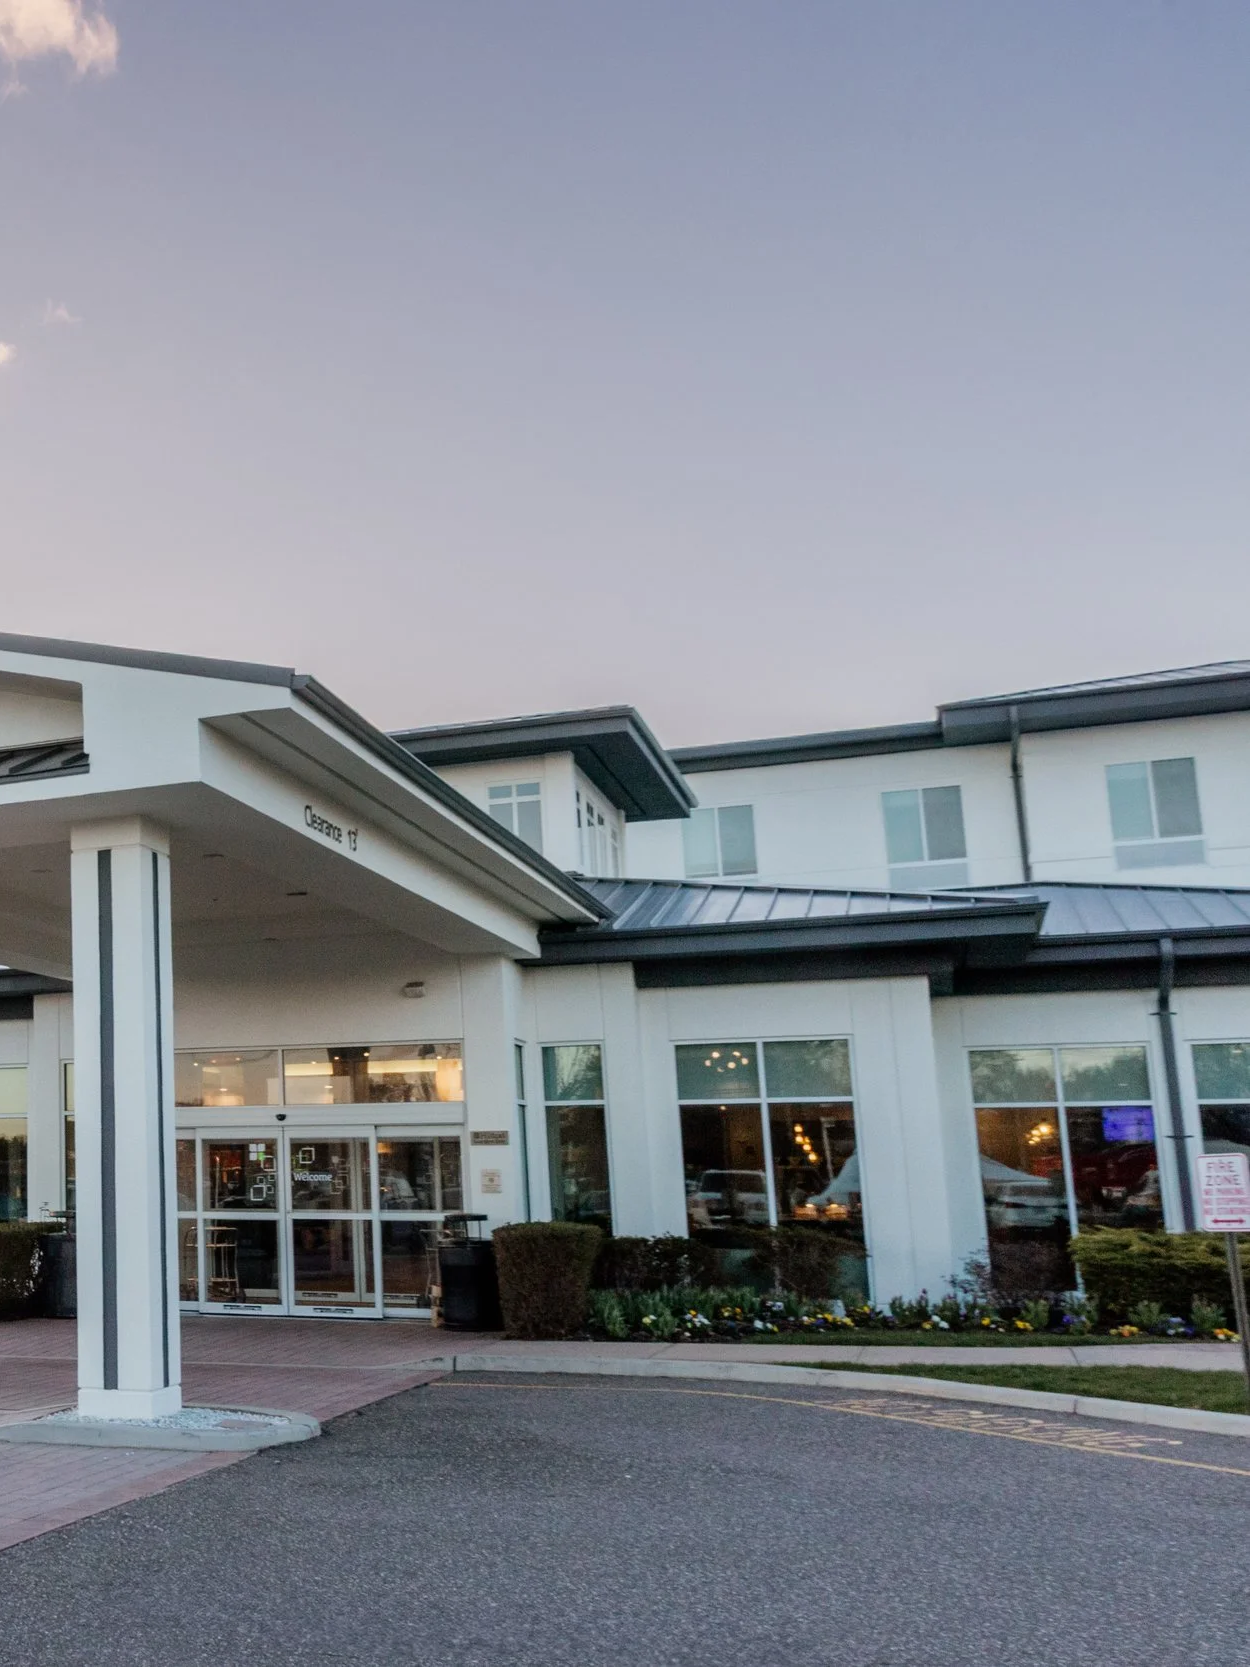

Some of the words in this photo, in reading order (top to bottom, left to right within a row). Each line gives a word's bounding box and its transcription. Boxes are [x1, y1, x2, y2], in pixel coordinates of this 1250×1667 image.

[1206, 1161, 1235, 1173] FIRE
[293, 1171, 333, 1181] Welcome
[1205, 1174, 1240, 1187] ZONE
